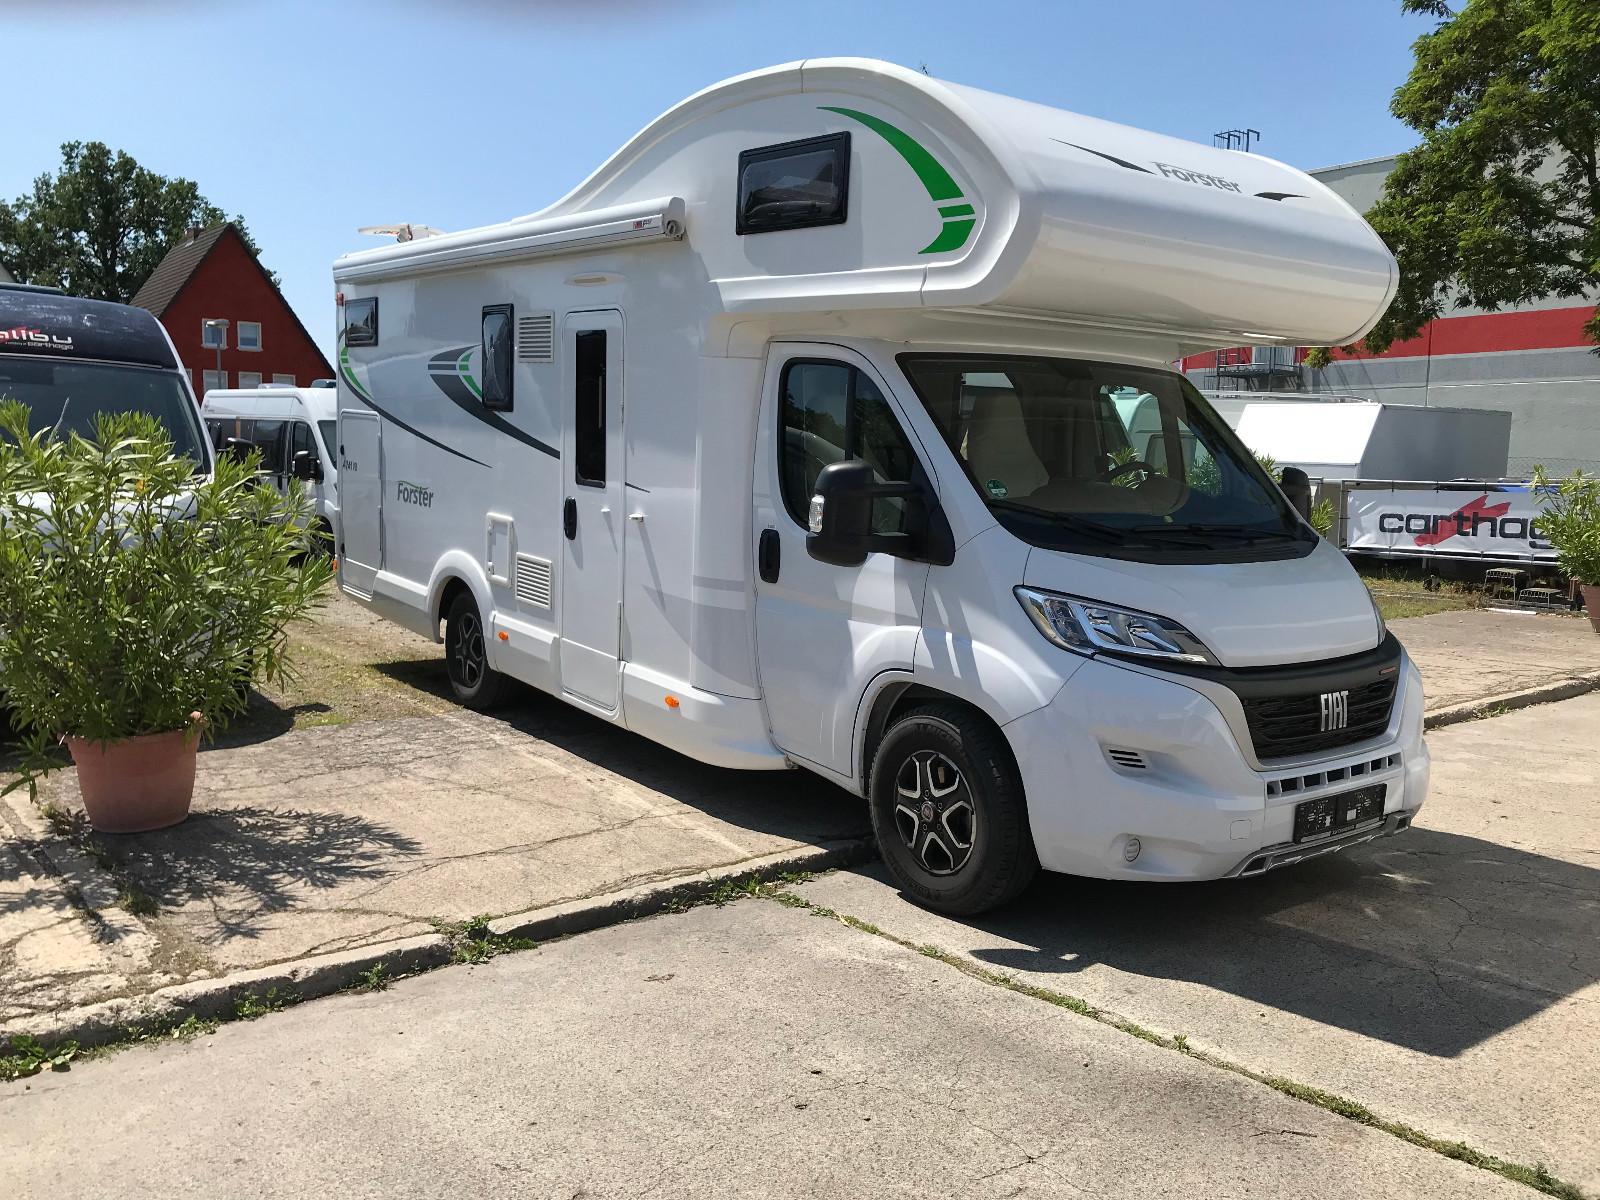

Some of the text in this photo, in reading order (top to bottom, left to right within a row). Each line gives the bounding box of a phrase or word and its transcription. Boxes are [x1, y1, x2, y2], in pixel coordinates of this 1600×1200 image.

[1153, 162, 1242, 193] Forster
[0, 329, 73, 344] alibu
[397, 481, 434, 508] Forster
[1379, 511, 1556, 549] carthag
[1320, 690, 1349, 732] FIAT
